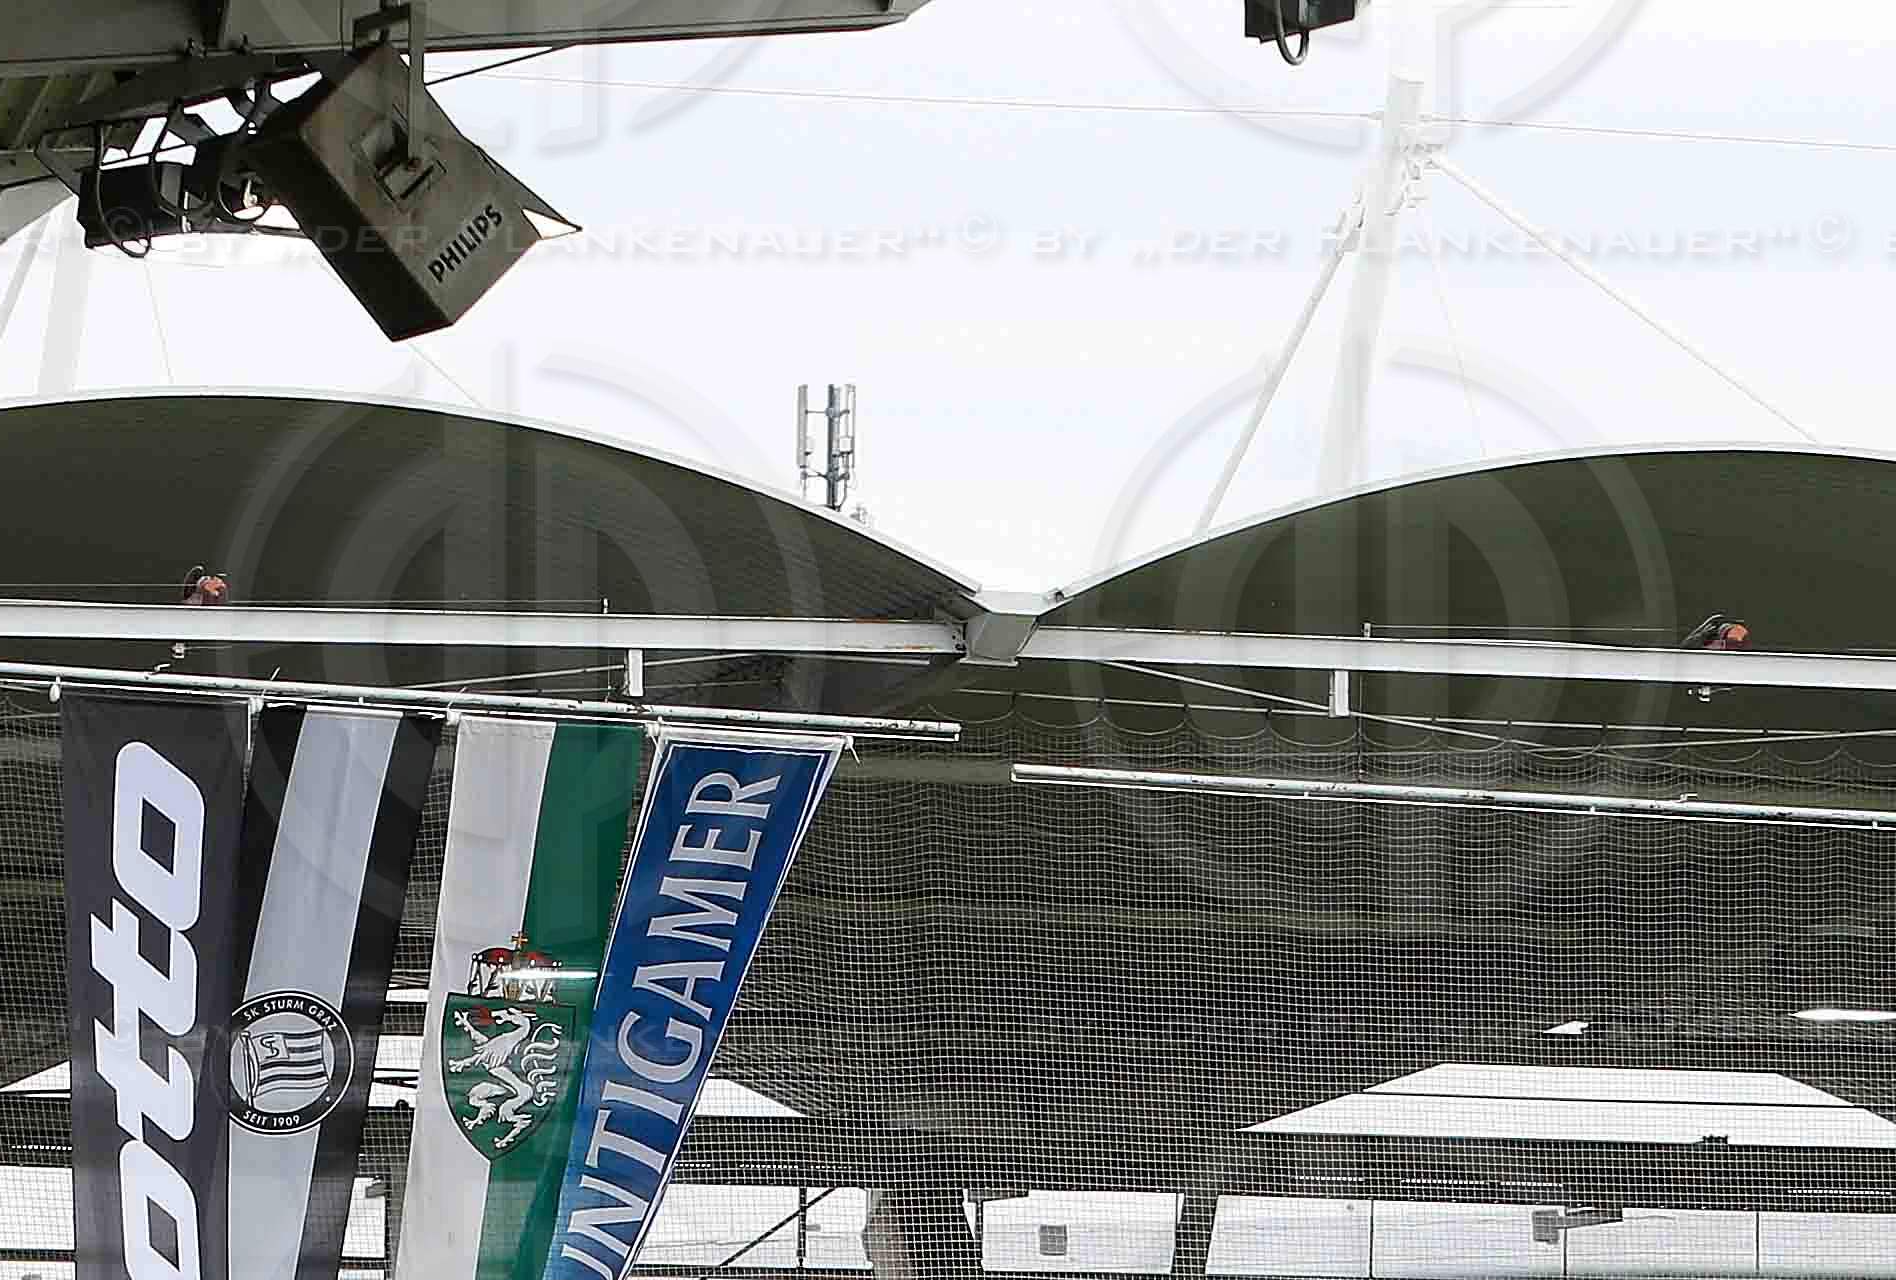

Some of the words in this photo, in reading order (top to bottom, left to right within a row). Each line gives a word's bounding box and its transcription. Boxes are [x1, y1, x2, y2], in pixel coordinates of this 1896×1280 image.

[427, 204, 503, 283] PHILIPS
[243, 1006, 261, 1022] SK
[263, 999, 304, 1014] STURM
[308, 1004, 339, 1032] GRAZ
[243, 1109, 267, 1126] SEIT
[272, 1114, 301, 1128] 1909
